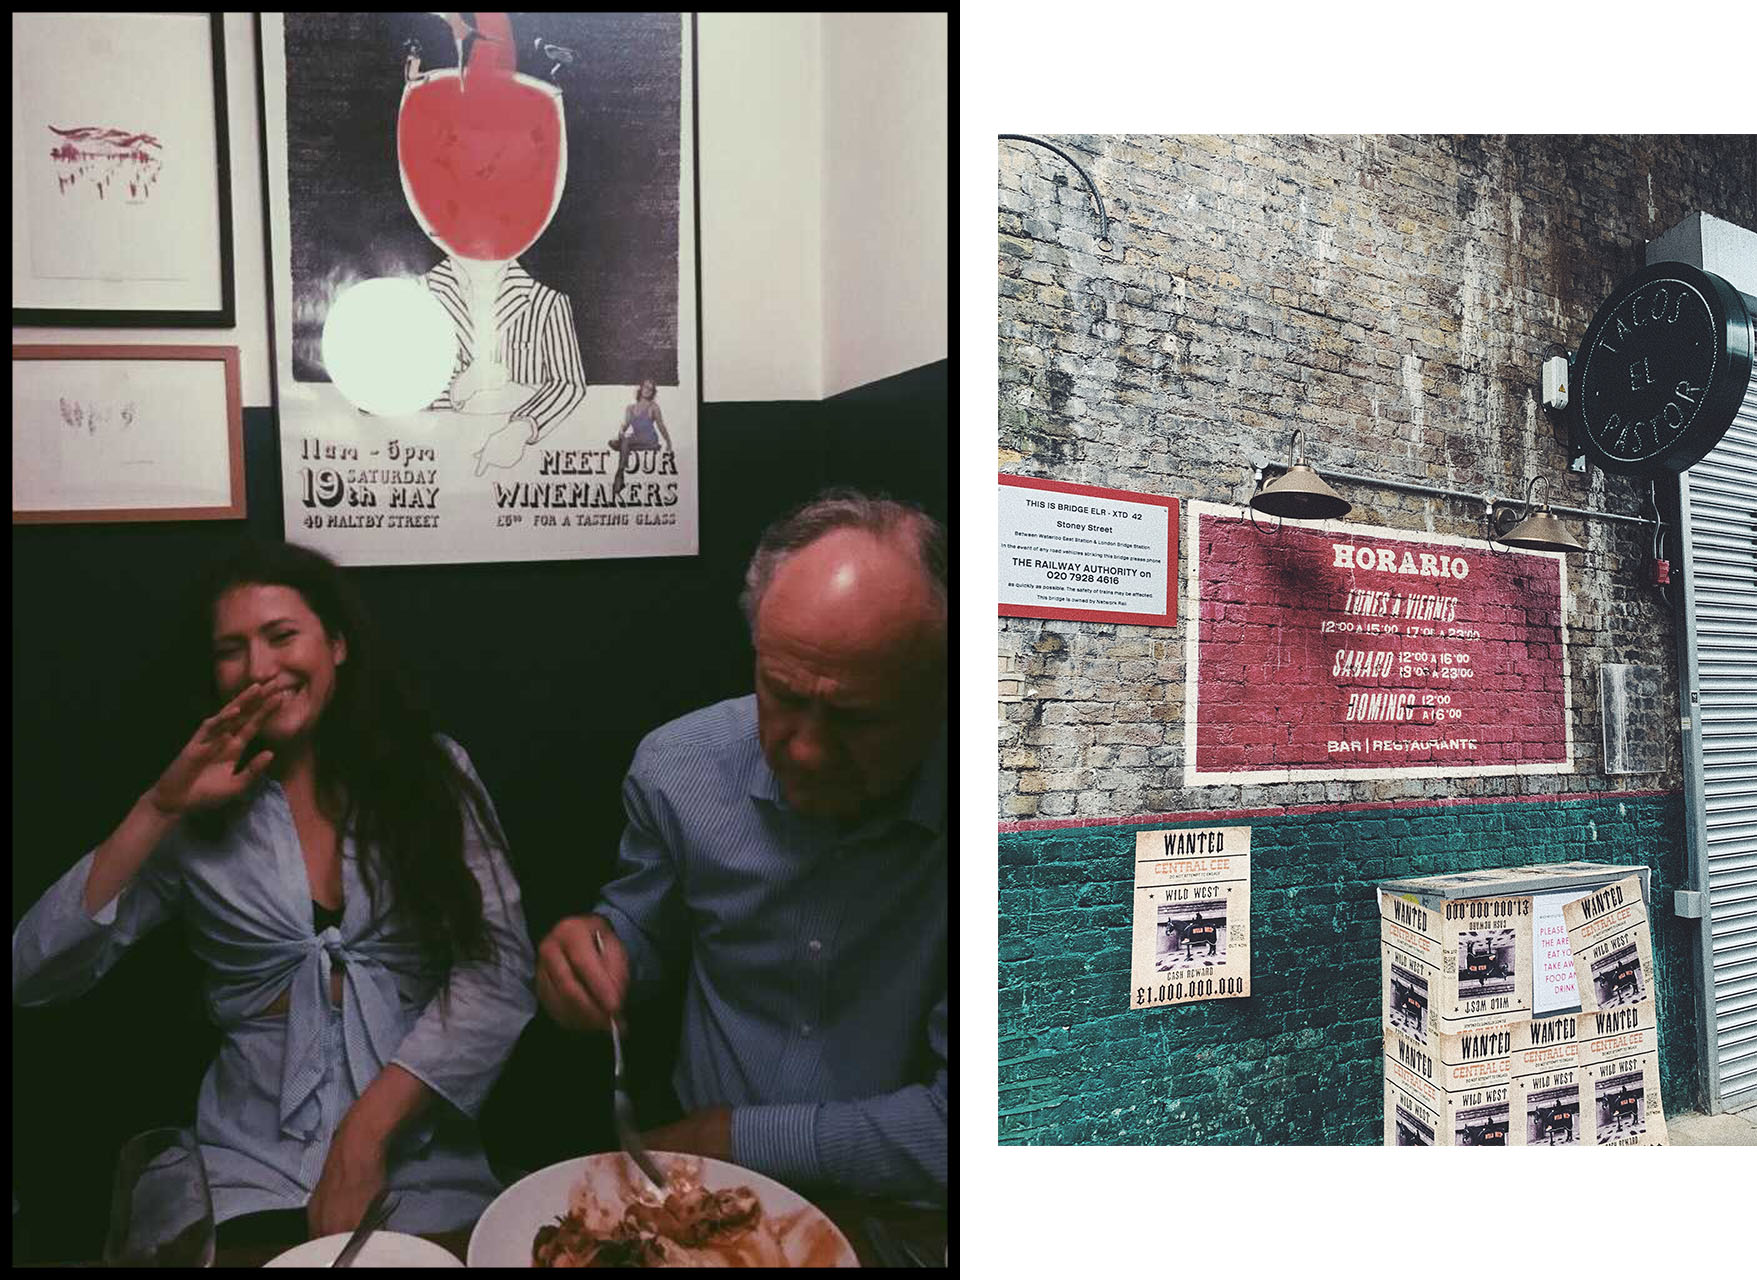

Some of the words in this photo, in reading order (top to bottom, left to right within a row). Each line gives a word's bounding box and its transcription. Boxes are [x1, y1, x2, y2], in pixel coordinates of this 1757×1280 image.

[1599, 288, 1689, 352] TACOS
[1629, 357, 1656, 391] EL
[1600, 380, 1705, 453] PASTOR
[302, 438, 358, 460] 11am
[540, 450, 610, 475] MEET
[622, 449, 679, 475] OUR
[347, 469, 437, 484] SATURDAY
[389, 487, 440, 508] MAY
[493, 481, 678, 508] WINEMAKERS
[533, 514, 557, 527] FOR
[561, 516, 571, 527] A
[576, 514, 629, 527] TASTING
[636, 513, 677, 526] GLASS
[1026, 499, 1045, 509] THIS
[1047, 502, 1056, 510] IS
[1057, 503, 1089, 514] BRIDGE
[1090, 507, 1107, 516] ELR
[1112, 510, 1129, 519] XTD
[1131, 513, 1143, 521] 42
[303, 515, 323, 528] 40
[327, 515, 384, 528] MALTBY
[387, 515, 440, 528] STREET
[1056, 520, 1086, 532] Stoney
[1087, 524, 1113, 534] Street
[1012, 557, 1032, 568] THE
[1034, 559, 1081, 572] RAILWAY
[1083, 564, 1138, 577] AUTHORITY
[1332, 544, 1470, 580] HORARIO
[1046, 571, 1067, 581] 020
[1069, 573, 1094, 583] 7928
[1096, 575, 1120, 585] 4616
[1344, 588, 1390, 618] LUNES
[1391, 594, 1402, 619] A
[1405, 593, 1459, 622] VIERNES
[1355, 624, 1363, 633] A
[1332, 649, 1394, 678] SABADO
[1430, 654, 1438, 664] A
[1346, 693, 1416, 721] DOMINGO
[1327, 740, 1362, 753] BAR
[1372, 738, 1478, 752] RESTAURANTE
[1164, 831, 1224, 856] WANTED
[1154, 861, 1208, 874] CENTRAL
[1210, 859, 1230, 871] CEE
[1165, 888, 1189, 901] WILD
[1193, 886, 1219, 899] WEST
[1581, 886, 1624, 920] WANTED
[1394, 900, 1427, 932] WANTED
[1581, 917, 1617, 938] CENTRAL
[1617, 907, 1632, 921] CEE
[1540, 926, 1564, 936] PLEASE
[1542, 939, 1554, 948] THE
[1556, 937, 1569, 945] ARE
[1593, 943, 1609, 959] WILD
[1611, 933, 1629, 950] WEST
[1394, 951, 1407, 967] WILD
[1409, 959, 1425, 976] WEST
[1547, 950, 1560, 959] EAT
[1562, 948, 1572, 957] YO
[1167, 971, 1184, 981] CASH
[1186, 967, 1214, 979] REWARD
[1544, 962, 1561, 971] TAKE
[1563, 960, 1574, 968] AW
[1545, 973, 1566, 983] FOOD
[1136, 976, 1243, 1006] £1.000.000.000
[1554, 984, 1575, 994] DRINK
[1464, 1001, 1487, 1014] WEST
[1491, 997, 1509, 1010] WILD
[1530, 1017, 1576, 1045] WANTED
[1595, 1007, 1638, 1035] WANTED
[1461, 1031, 1511, 1060] WANTED
[1590, 1037, 1628, 1053] CENTRAL
[1629, 1032, 1643, 1045] CEE
[1399, 1039, 1432, 1079] WANTED
[1523, 1047, 1564, 1063] CENTRAL
[1453, 1062, 1497, 1079] CENTRAL
[1499, 1060, 1511, 1072] CE
[1599, 1063, 1616, 1077] WILD
[1619, 1058, 1638, 1073] WEST
[1394, 1063, 1423, 1093] CENTRAL
[1423, 1085, 1436, 1101] CEE
[1532, 1077, 1550, 1090] WILD
[1554, 1071, 1573, 1085] WEST
[1463, 1092, 1482, 1107] WILD
[1485, 1088, 1508, 1103] WEST
[1400, 1093, 1412, 1111] WILD
[1415, 1102, 1430, 1124] WEST
